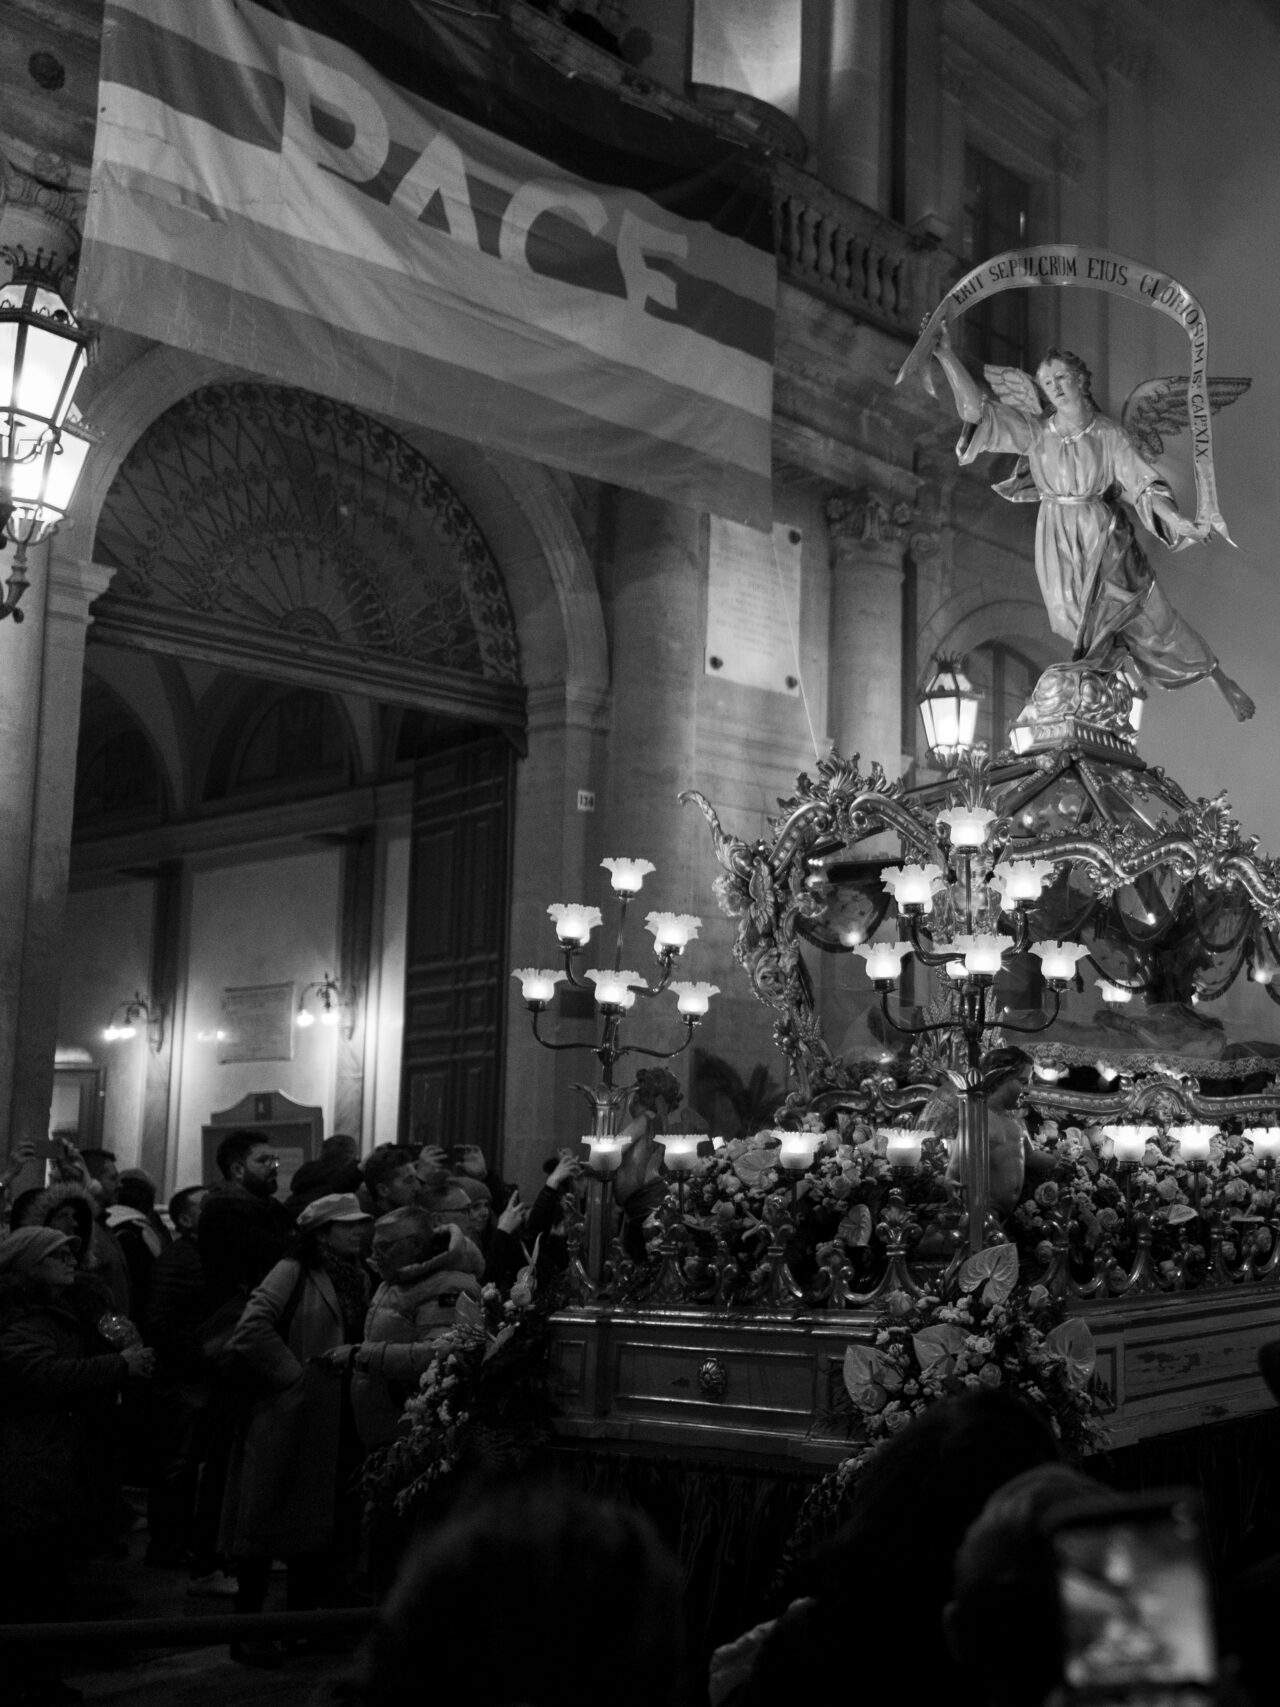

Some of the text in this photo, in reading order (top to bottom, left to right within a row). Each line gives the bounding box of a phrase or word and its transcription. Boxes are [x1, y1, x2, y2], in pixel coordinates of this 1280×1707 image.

[278, 44, 690, 340] PACE
[952, 273, 984, 305] ERIT
[988, 255, 1077, 282] SEPULCRUM
[1087, 257, 1129, 287] EIUS
